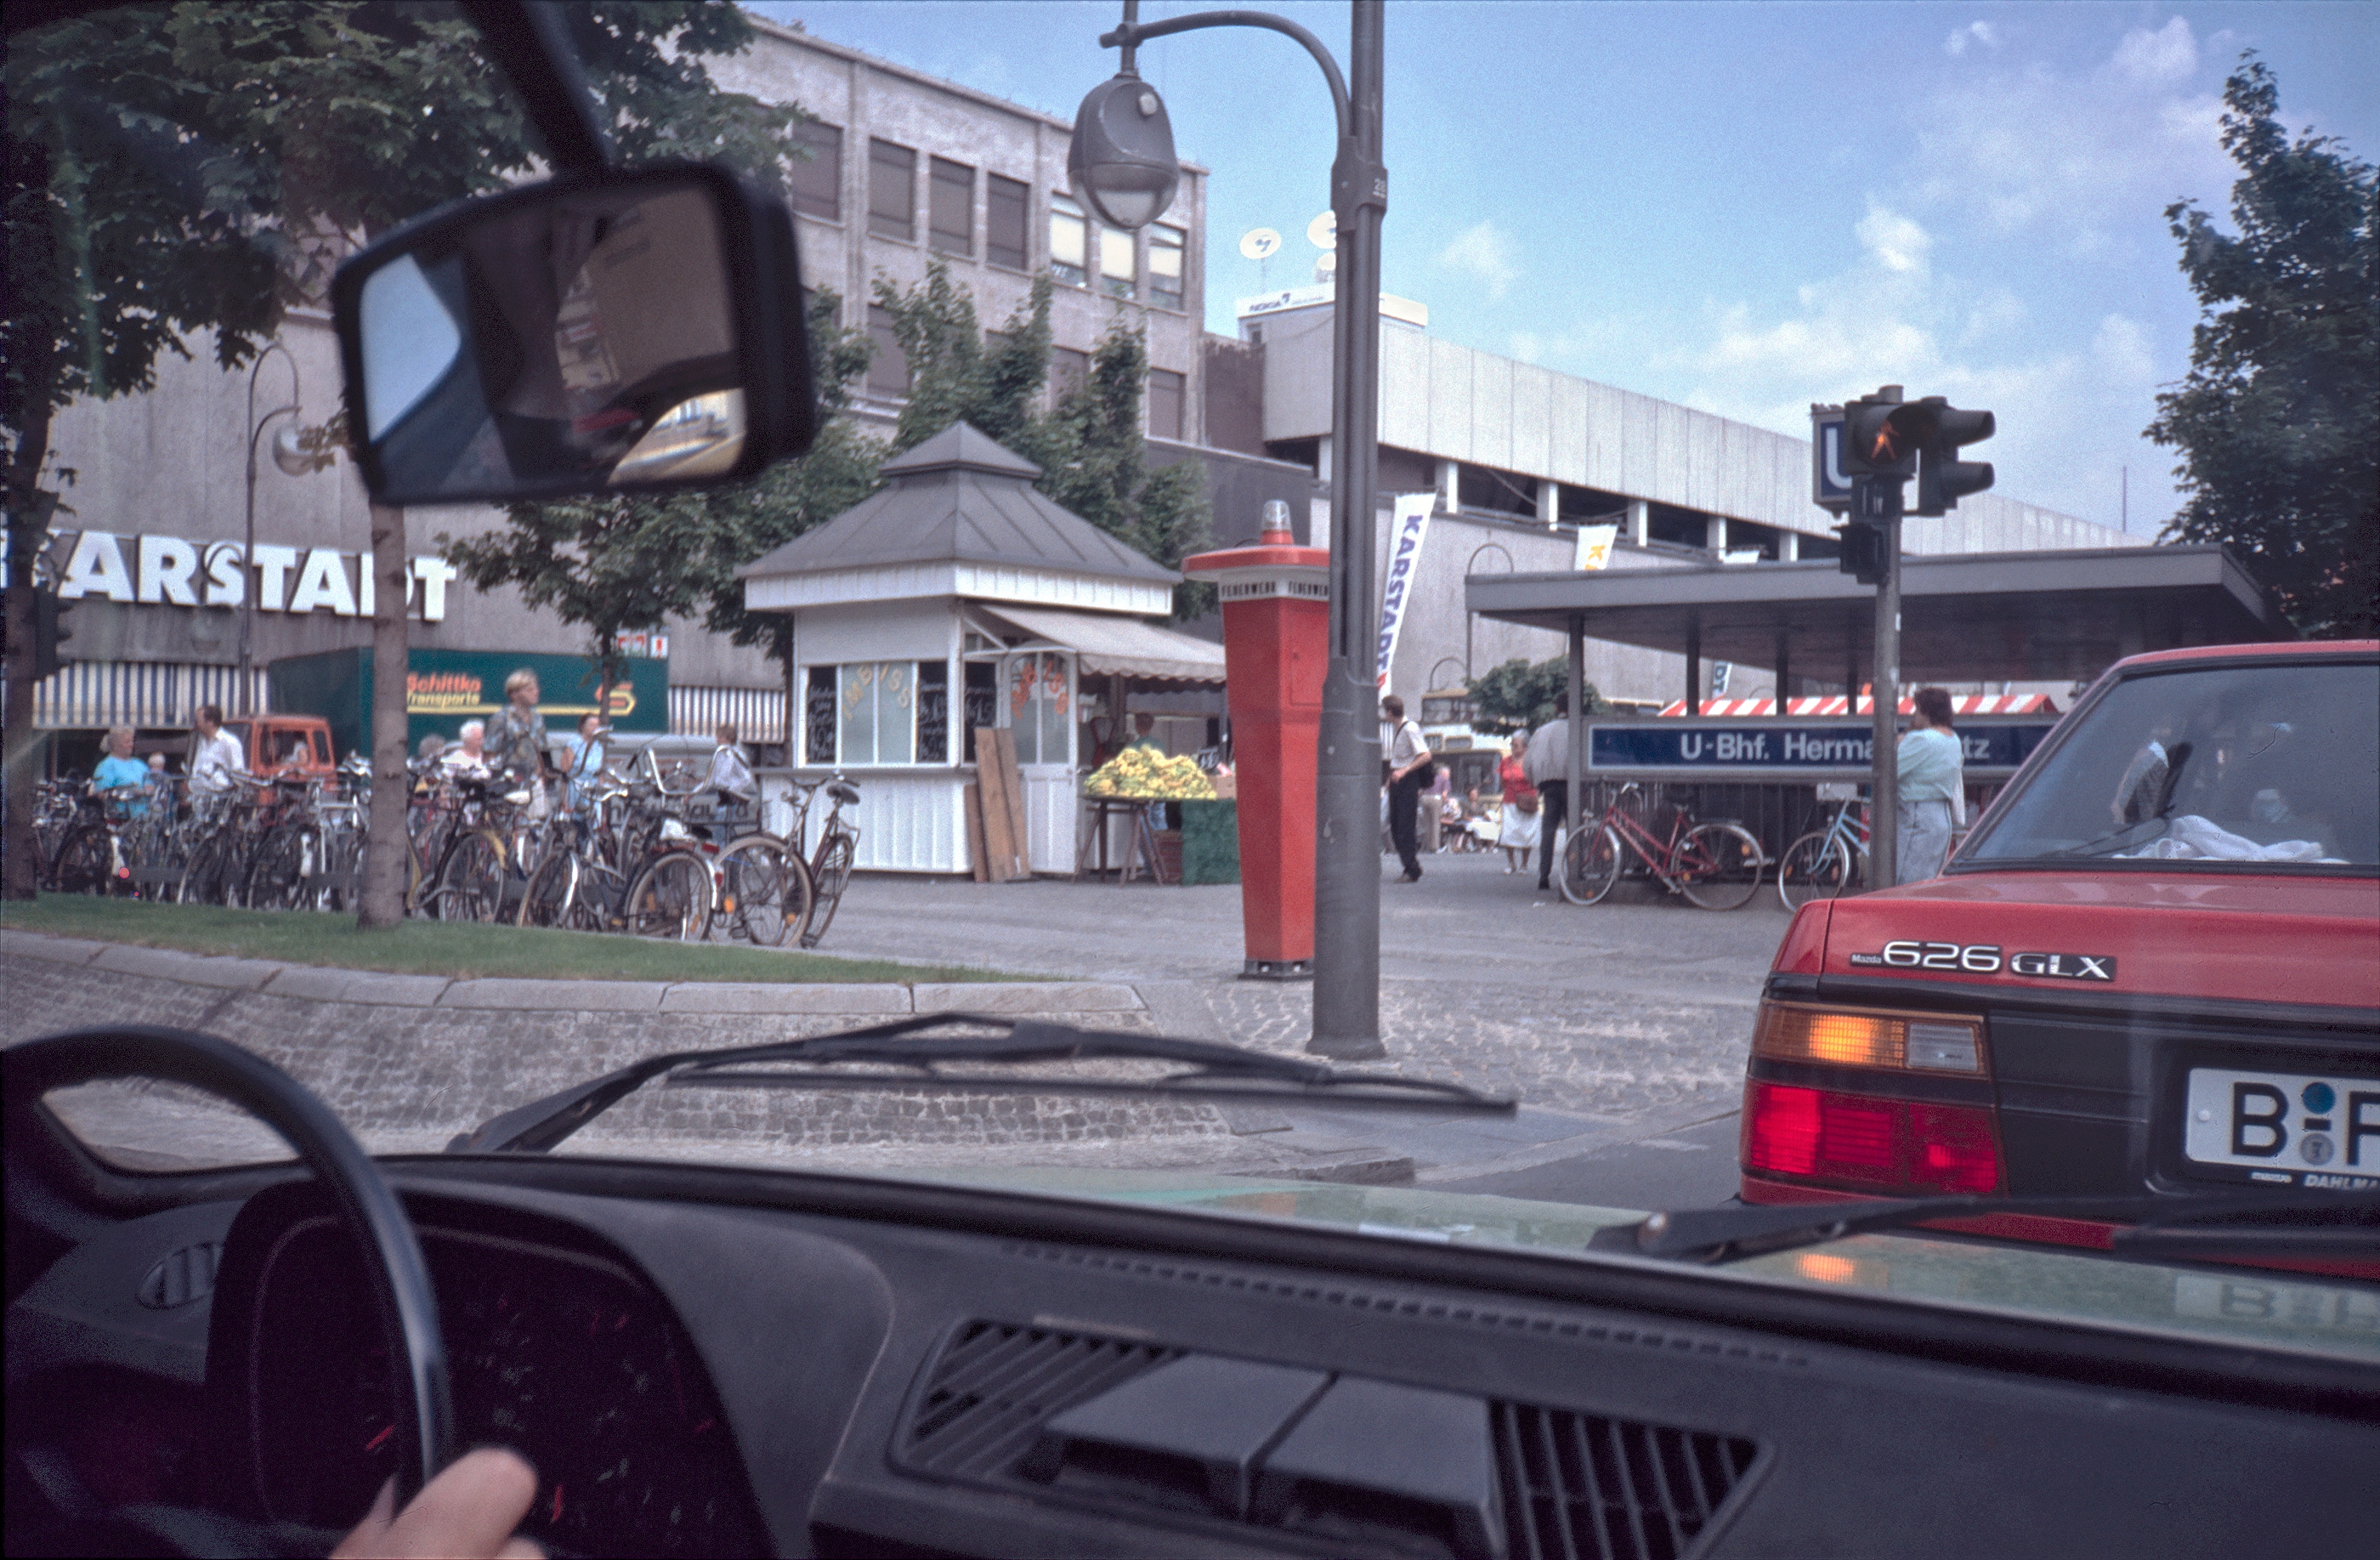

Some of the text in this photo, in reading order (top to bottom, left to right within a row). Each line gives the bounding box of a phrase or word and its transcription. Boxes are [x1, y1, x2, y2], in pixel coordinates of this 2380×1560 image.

[1377, 514, 1425, 671] KARSTADT
[1851, 940, 2110, 979] Mazda 626 GLX
